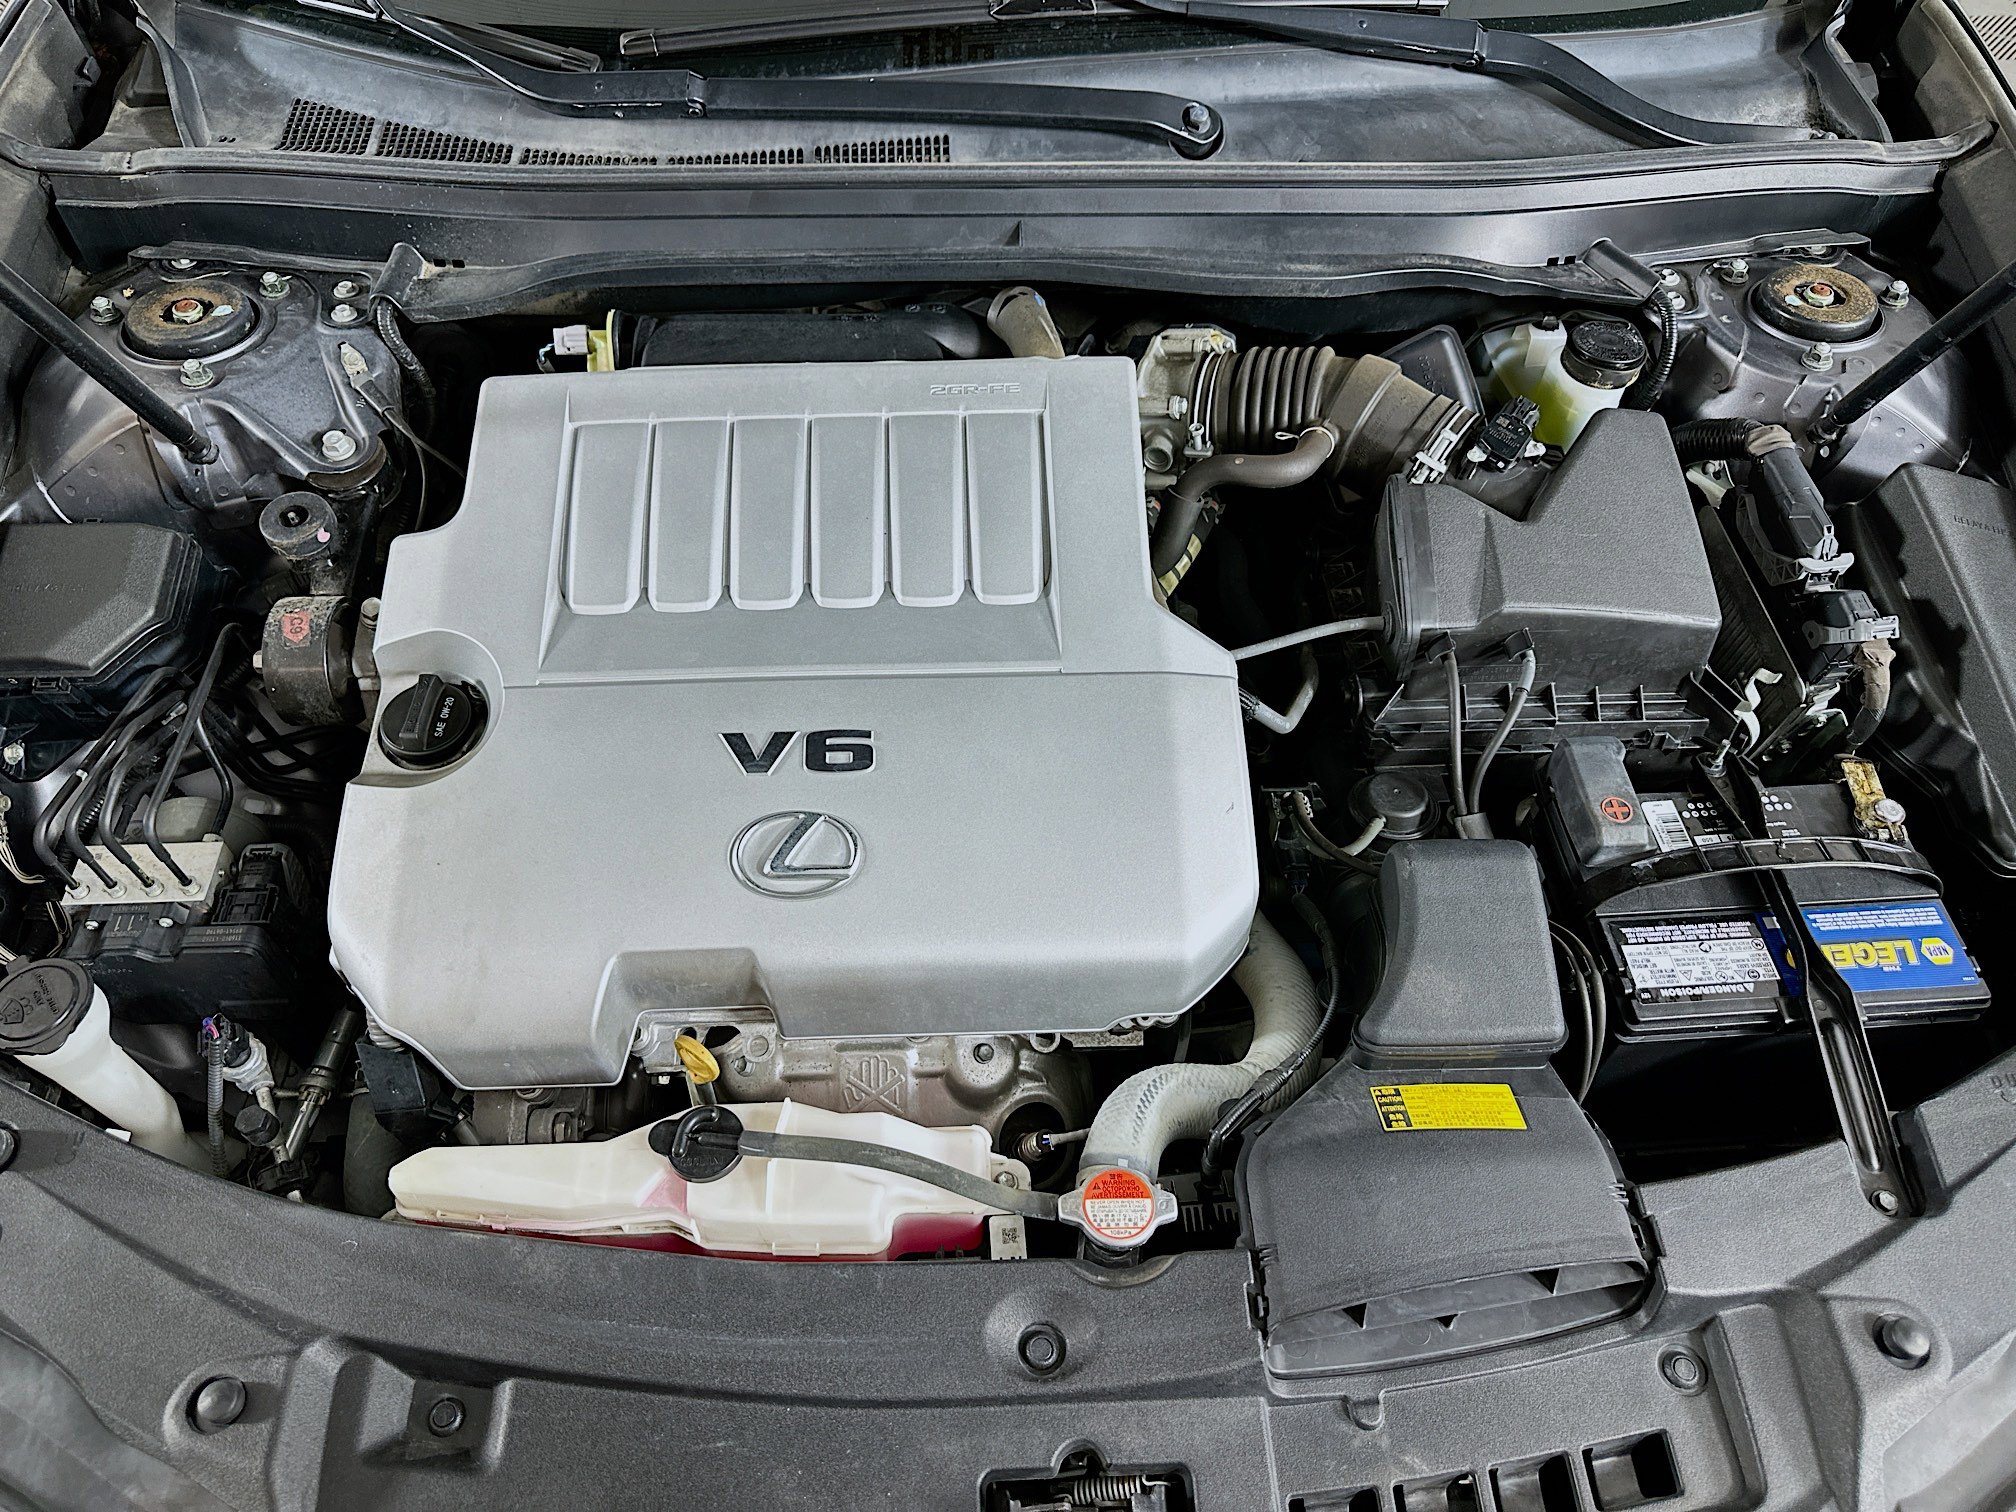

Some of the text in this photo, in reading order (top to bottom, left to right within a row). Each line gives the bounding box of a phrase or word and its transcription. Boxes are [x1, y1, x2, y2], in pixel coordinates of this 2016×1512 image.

[930, 383, 1020, 396] 2GR-FE
[434, 697, 455, 737] SAE 0W-20
[718, 729, 877, 776] V6
[1821, 940, 1921, 970] LEGE
[1925, 945, 1950, 957] NAPA
[1659, 983, 1745, 997] DANGER/POISON
[1377, 1095, 1403, 1103] CAUTION
[1381, 1104, 1407, 1112] ATTENTION
[1091, 1191, 1145, 1199] AVERTISSEMENT
